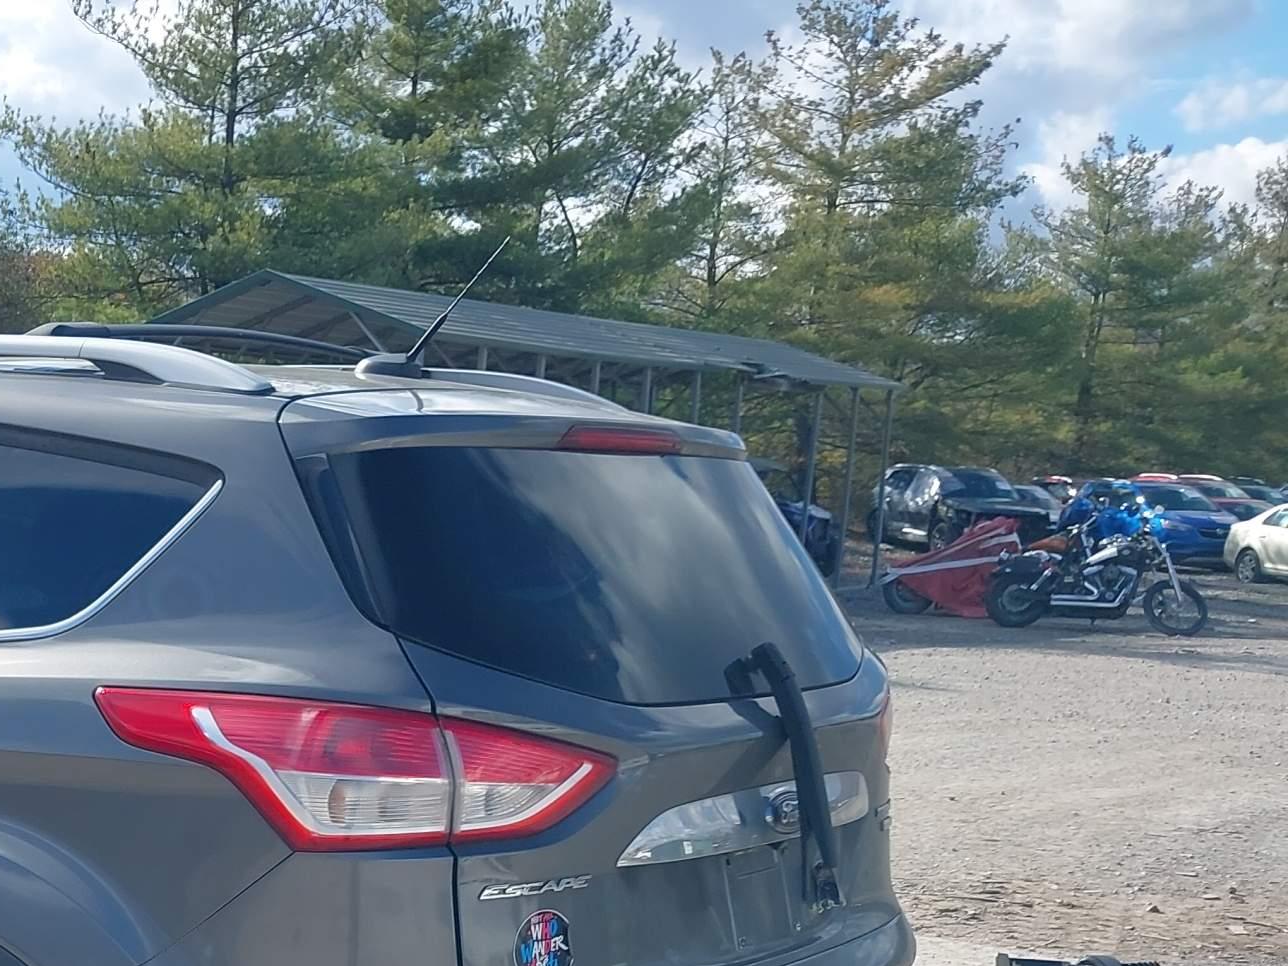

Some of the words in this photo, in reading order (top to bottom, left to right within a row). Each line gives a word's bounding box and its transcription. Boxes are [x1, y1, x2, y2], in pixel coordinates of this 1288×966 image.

[479, 874, 593, 901] ESCAPE
[530, 919, 559, 941] WHO
[520, 935, 569, 964] WANDER
